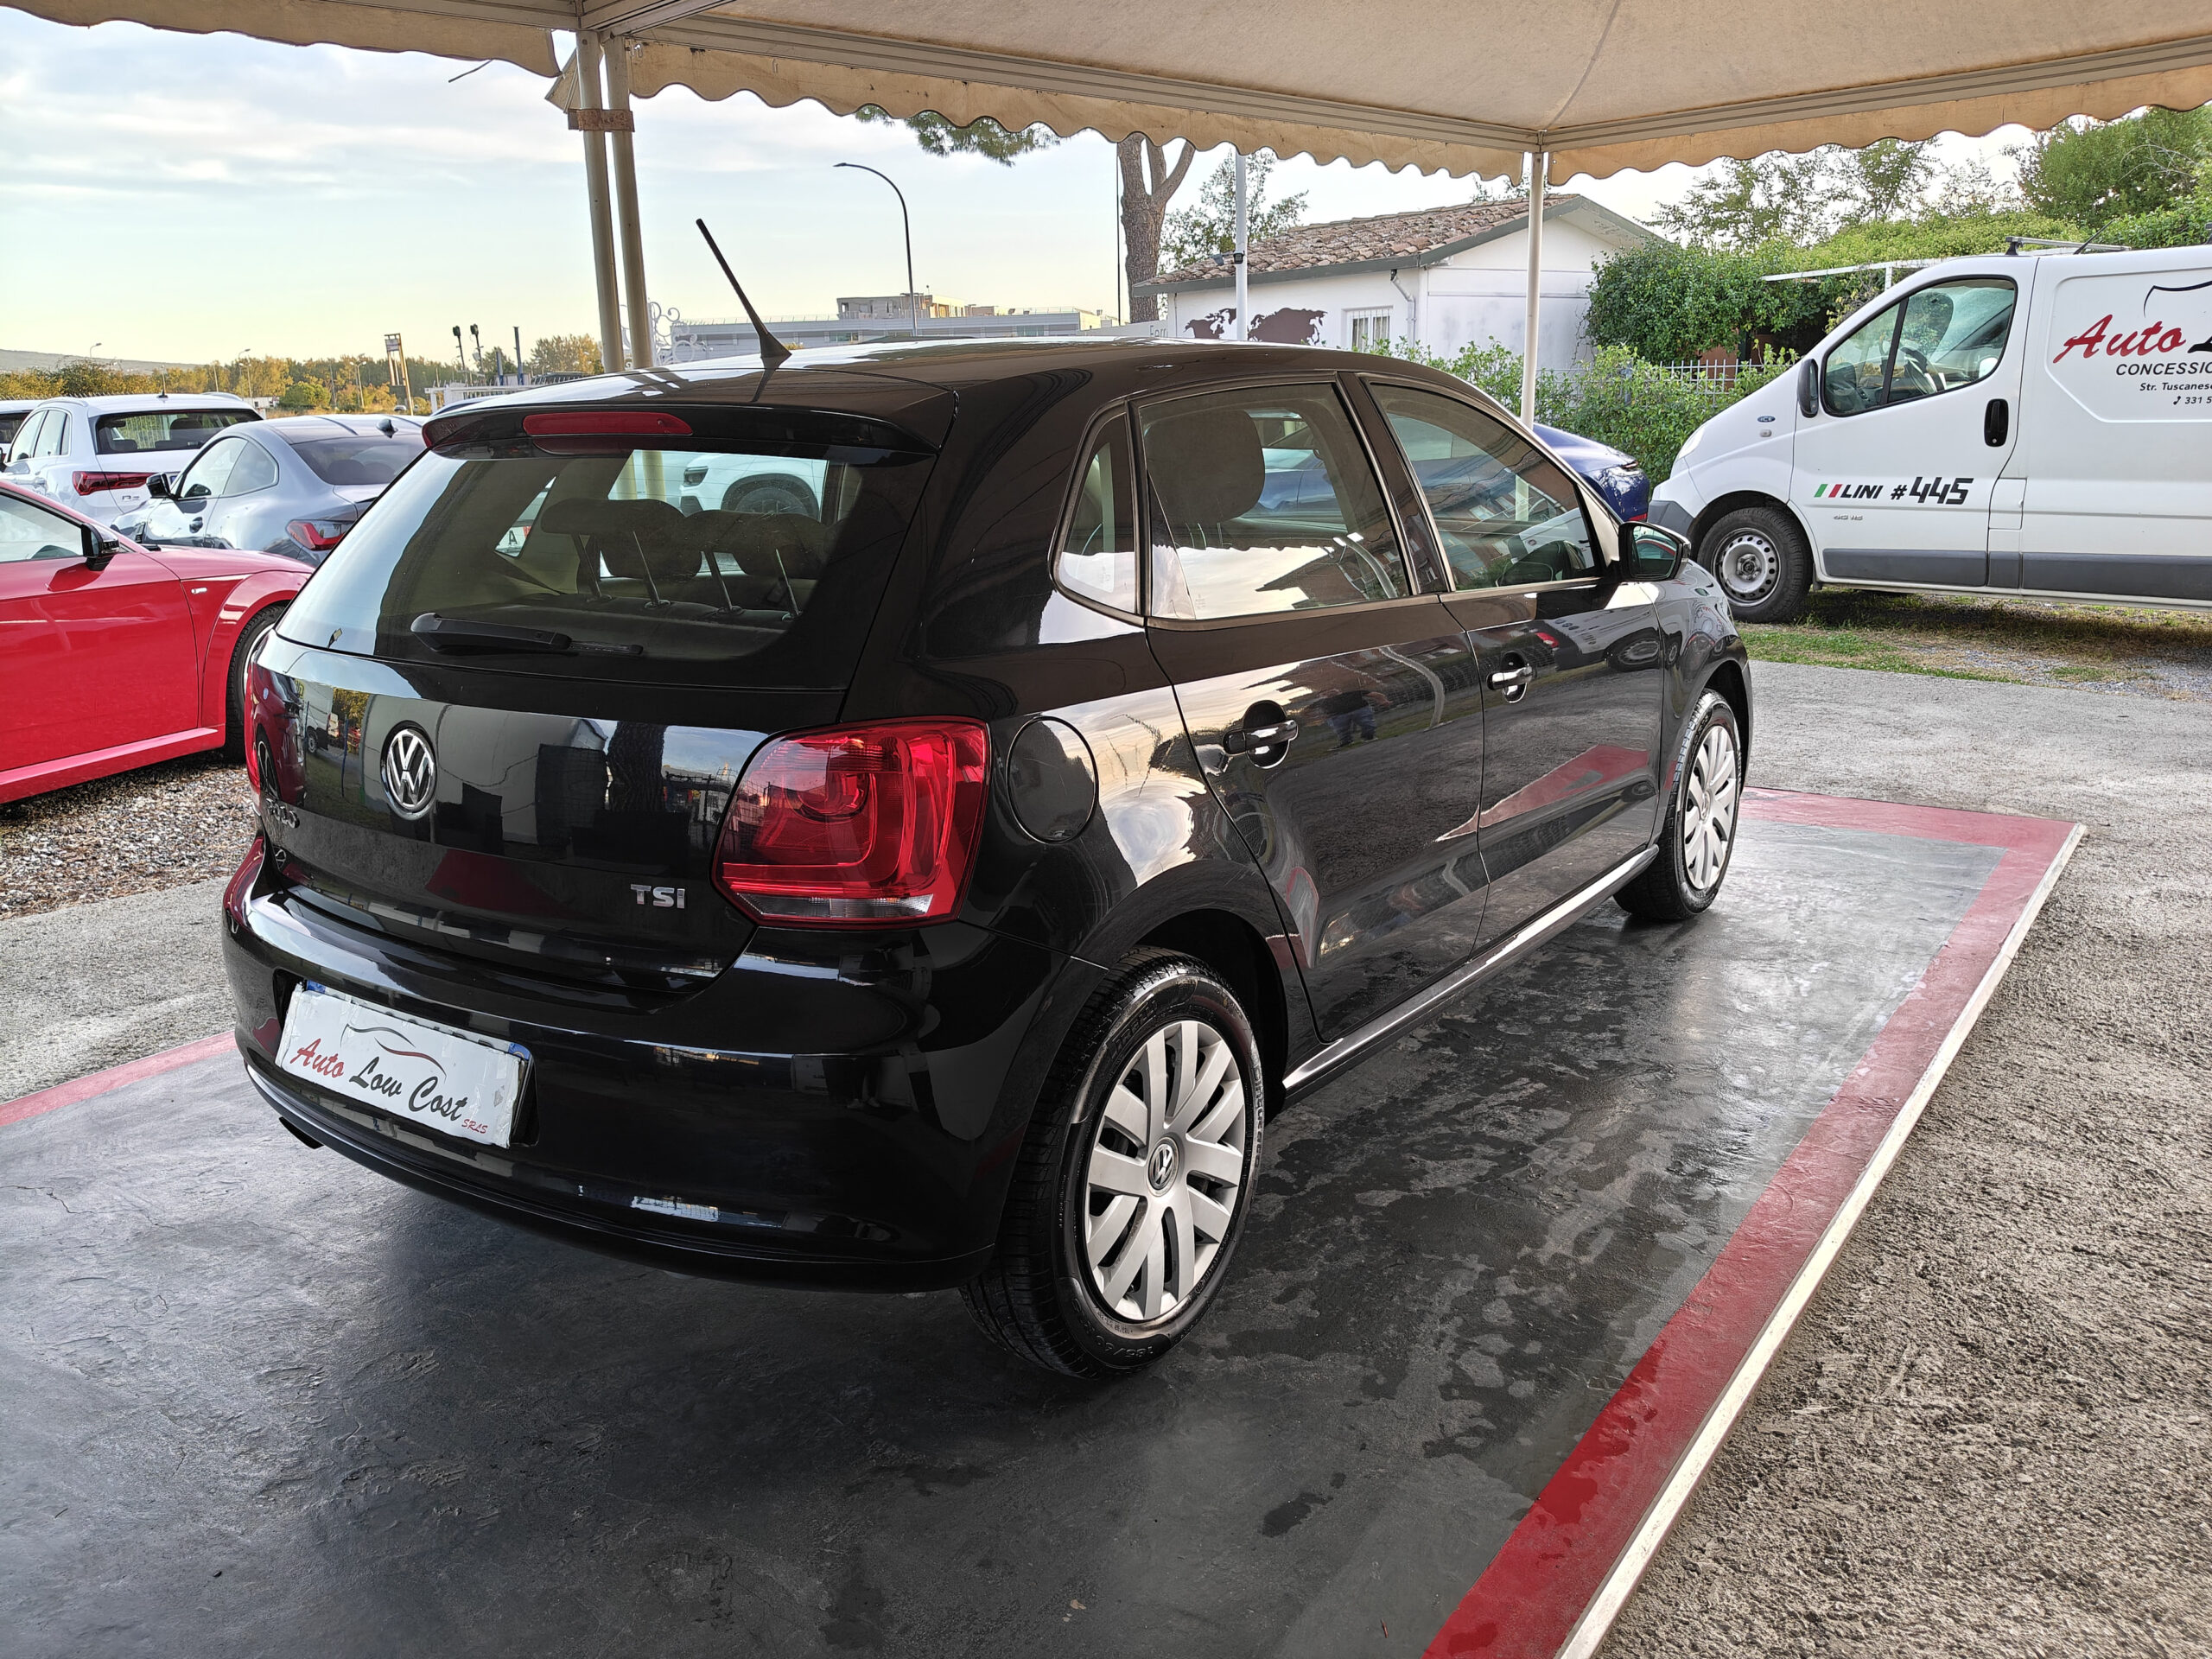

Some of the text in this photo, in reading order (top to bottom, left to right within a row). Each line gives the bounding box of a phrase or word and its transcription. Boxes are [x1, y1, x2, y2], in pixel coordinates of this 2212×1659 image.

[2052, 314, 2187, 364] Auto
[2139, 382, 2212, 391] Str. Tuscanes
[2184, 396, 2202, 404] 331
[630, 883, 685, 909] TSI
[289, 1038, 344, 1078] Auto
[348, 1056, 402, 1097] Low
[408, 1076, 468, 1122] Cost
